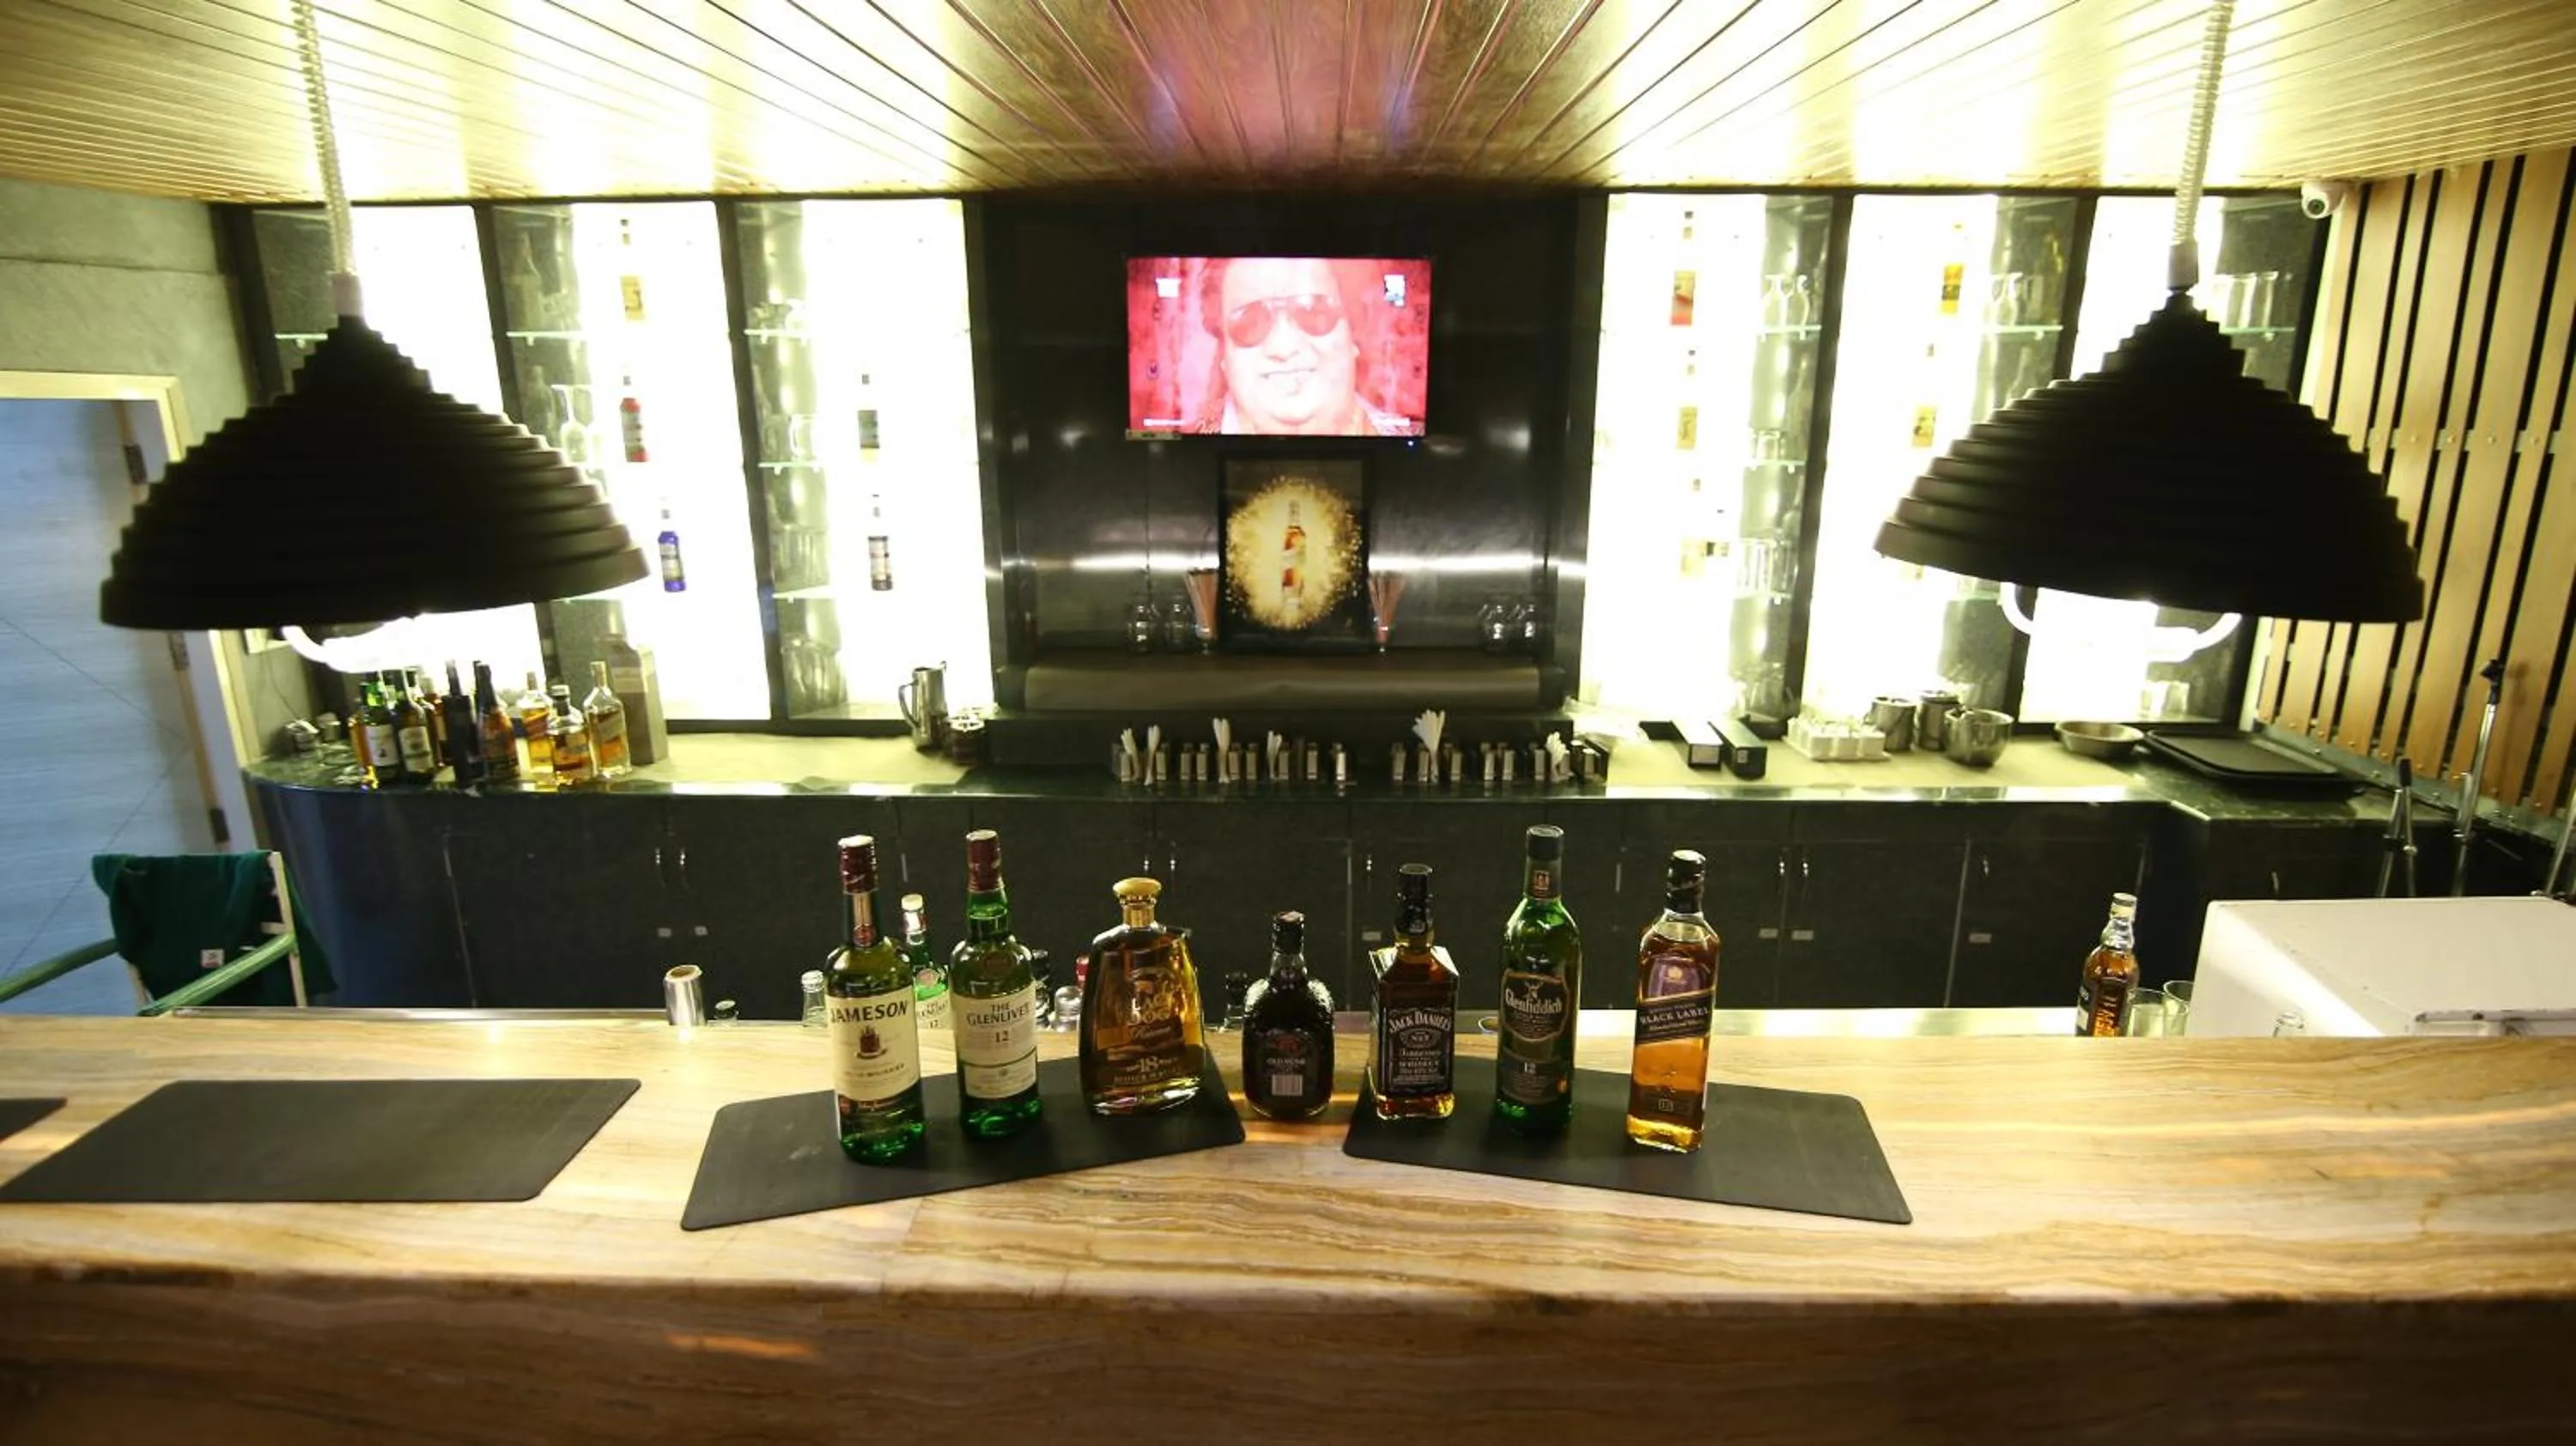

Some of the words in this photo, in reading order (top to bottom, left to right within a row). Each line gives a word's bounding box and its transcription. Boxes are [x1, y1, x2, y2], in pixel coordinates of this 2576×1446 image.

[991, 1001, 1011, 1012] THE
[1504, 987, 1564, 1014] Glenfiddich
[830, 999, 908, 1024] JAMESON
[966, 1002, 1031, 1026] GLENLIVET
[1639, 1012, 1674, 1025] BLACK
[1675, 1006, 1710, 1020] LABEL
[1388, 1015, 1415, 1035] JACK
[994, 1030, 1011, 1043] 12
[1140, 1055, 1160, 1072] 18
